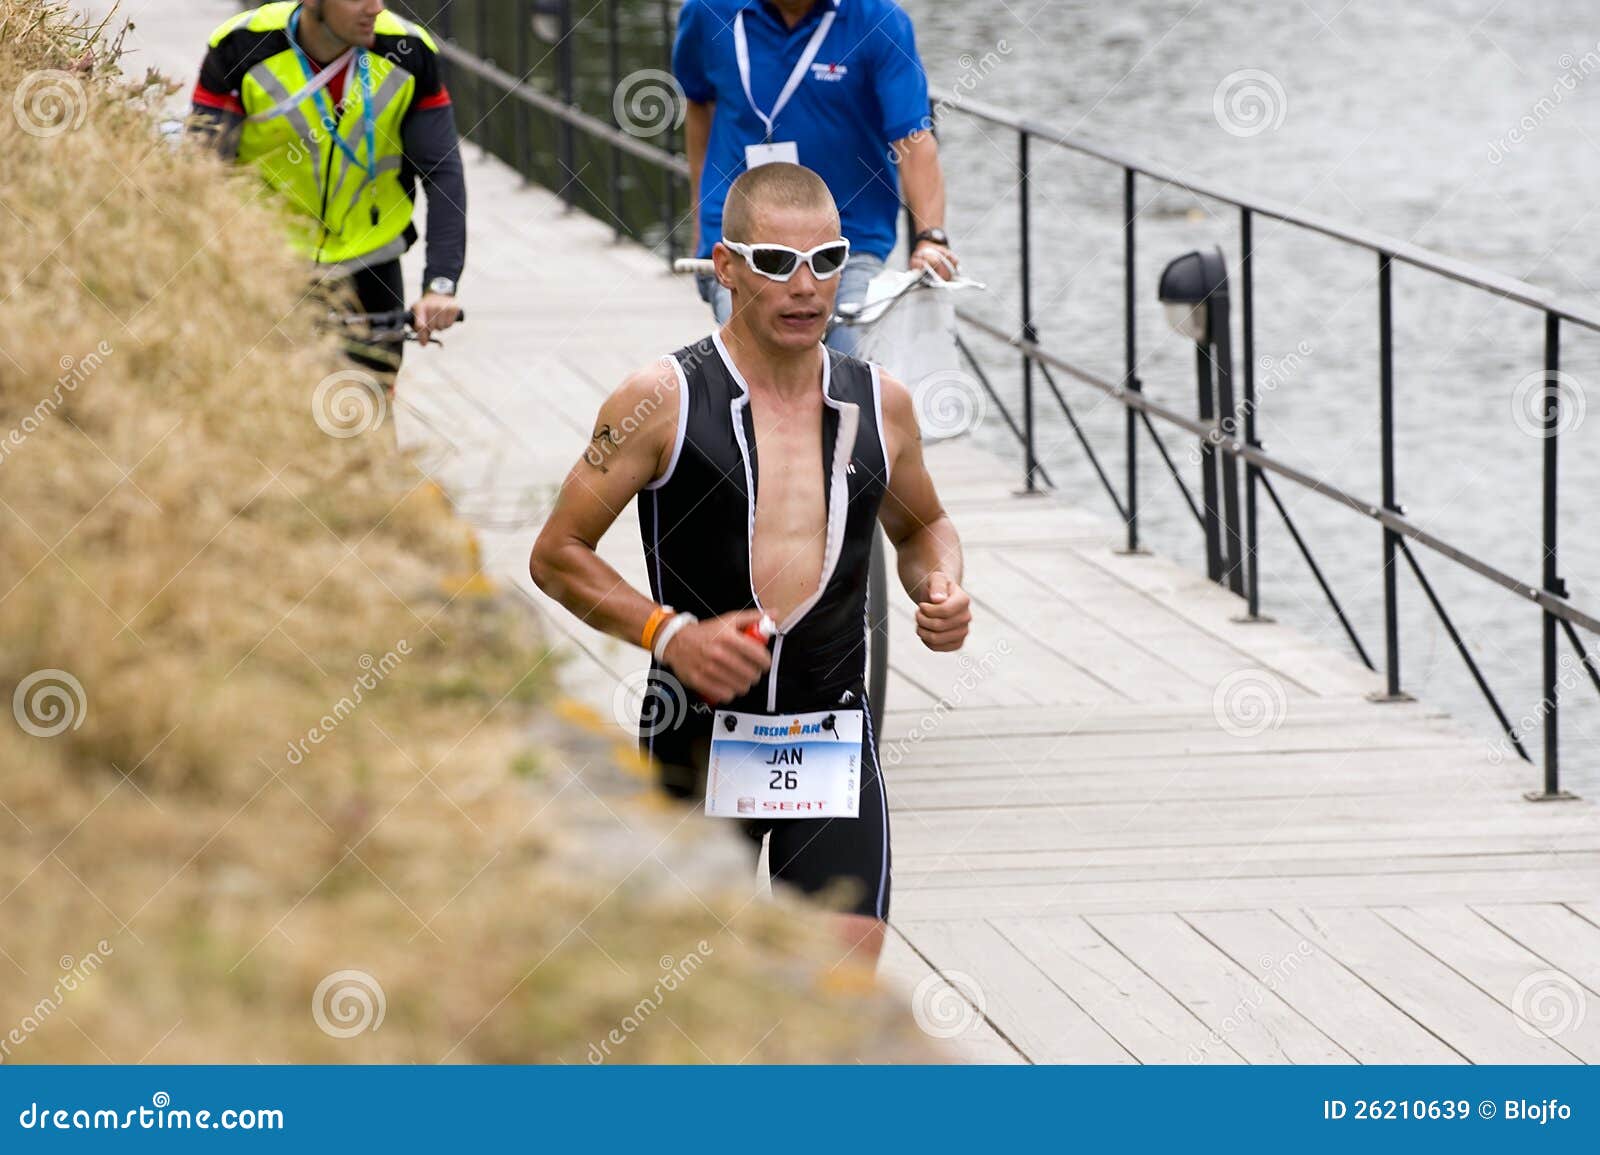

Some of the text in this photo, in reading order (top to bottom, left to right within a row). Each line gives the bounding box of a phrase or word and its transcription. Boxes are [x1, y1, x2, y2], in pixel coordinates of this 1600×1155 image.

[753, 719, 821, 737] IRONMAN
[766, 747, 803, 766] JAN
[769, 770, 798, 791] 26
[761, 800, 827, 811] SEAT
